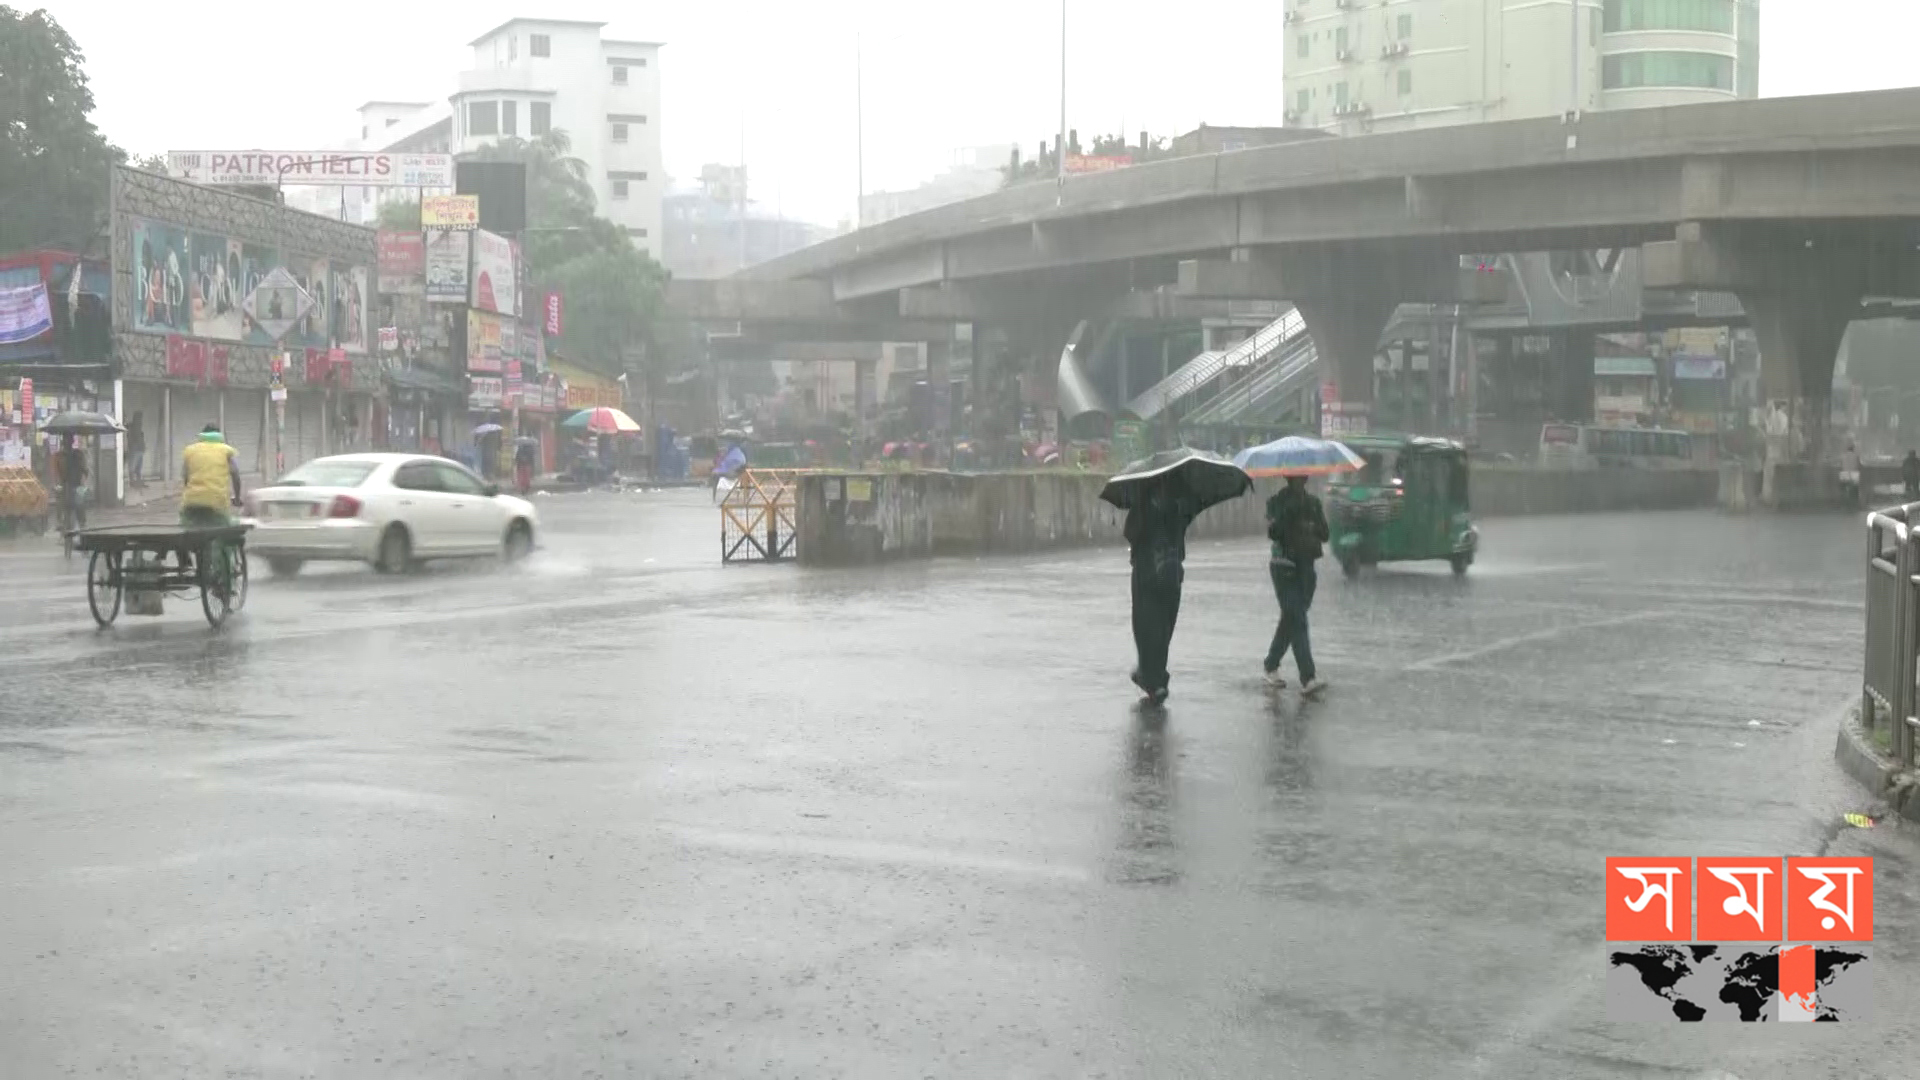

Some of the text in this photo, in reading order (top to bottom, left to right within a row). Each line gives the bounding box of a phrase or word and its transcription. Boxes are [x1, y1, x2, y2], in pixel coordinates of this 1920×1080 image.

[211, 154, 313, 174] PATRON
[322, 155, 391, 175] IELTS
[547, 295, 559, 335] Bata
